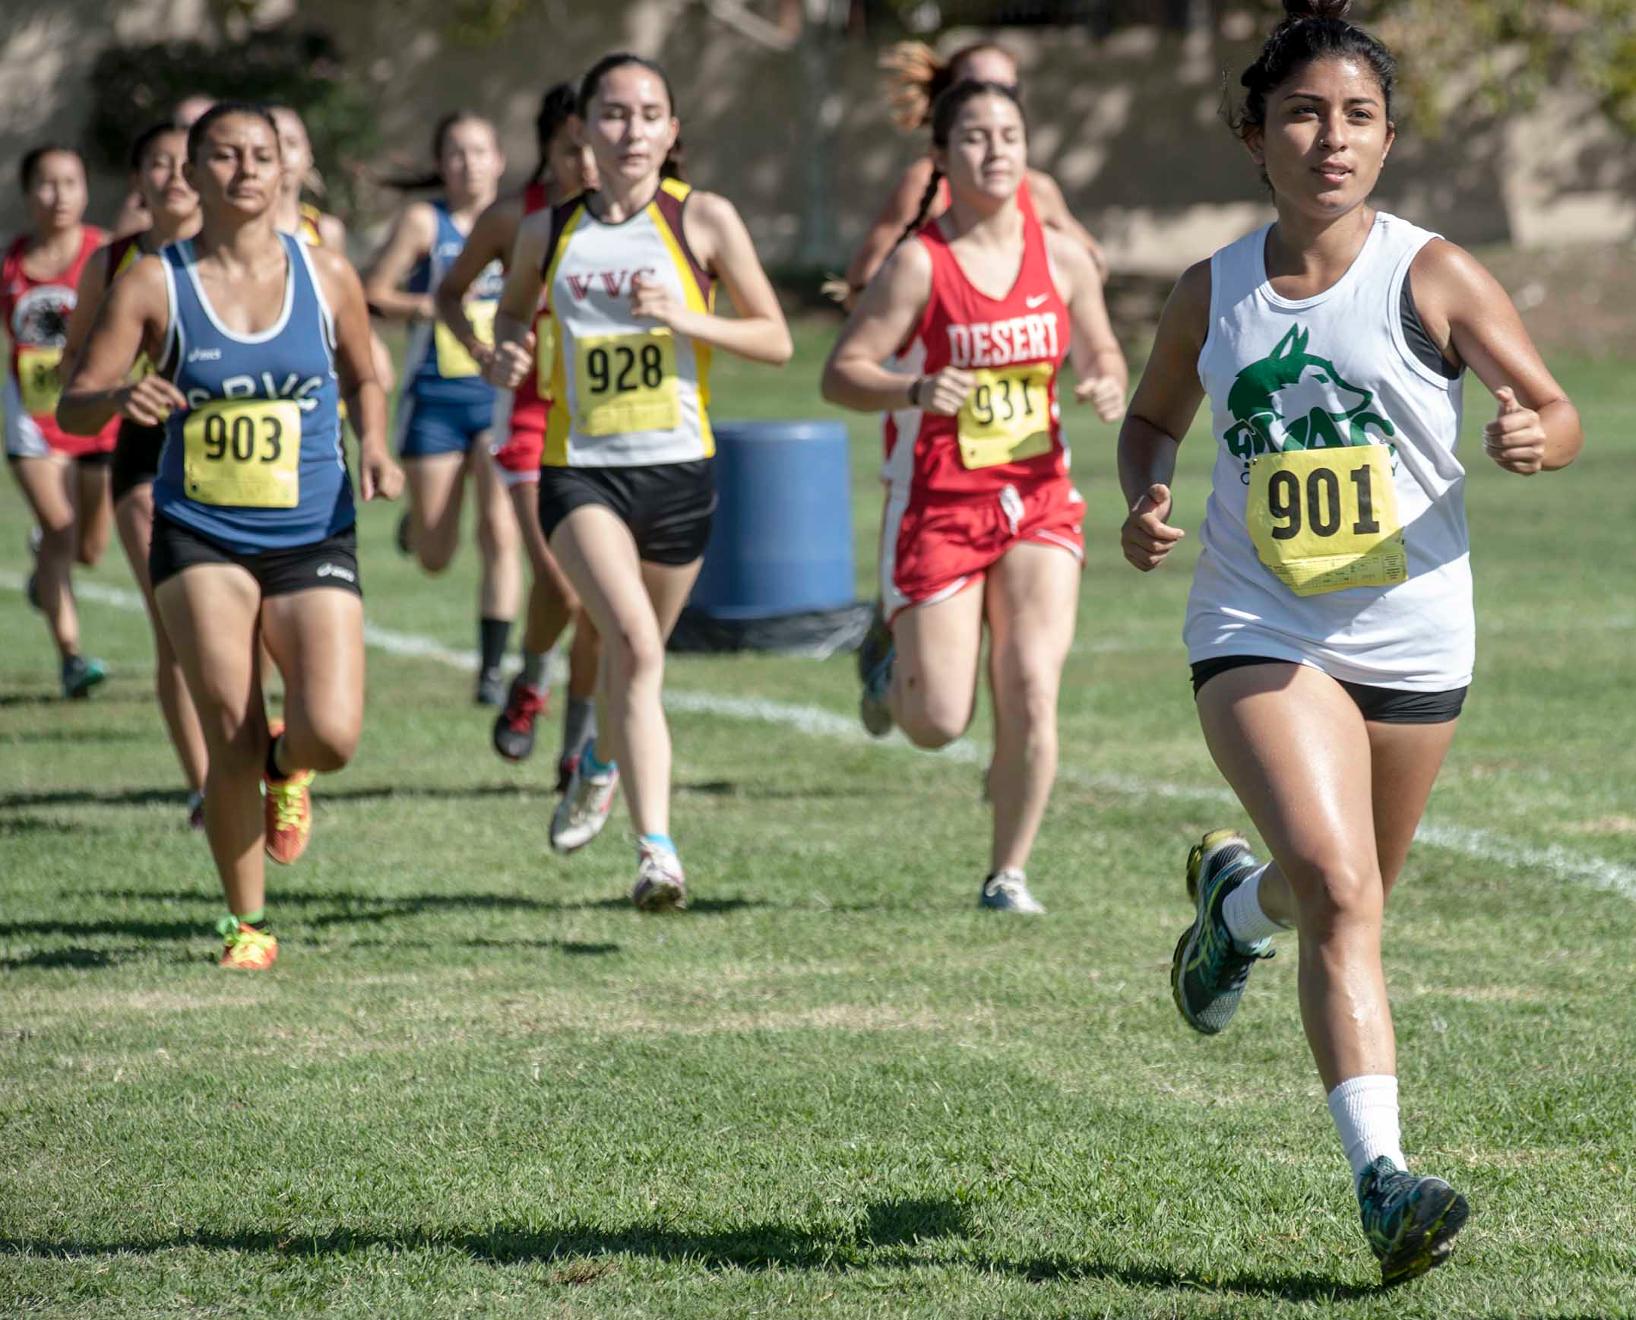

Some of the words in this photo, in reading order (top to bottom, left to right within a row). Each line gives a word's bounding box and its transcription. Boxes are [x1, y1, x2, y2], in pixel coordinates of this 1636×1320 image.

[947, 312, 1058, 367] DESERT
[587, 344, 662, 394] 928
[976, 376, 1033, 425] 931
[204, 414, 283, 462] 903
[1268, 464, 1380, 540] 901
